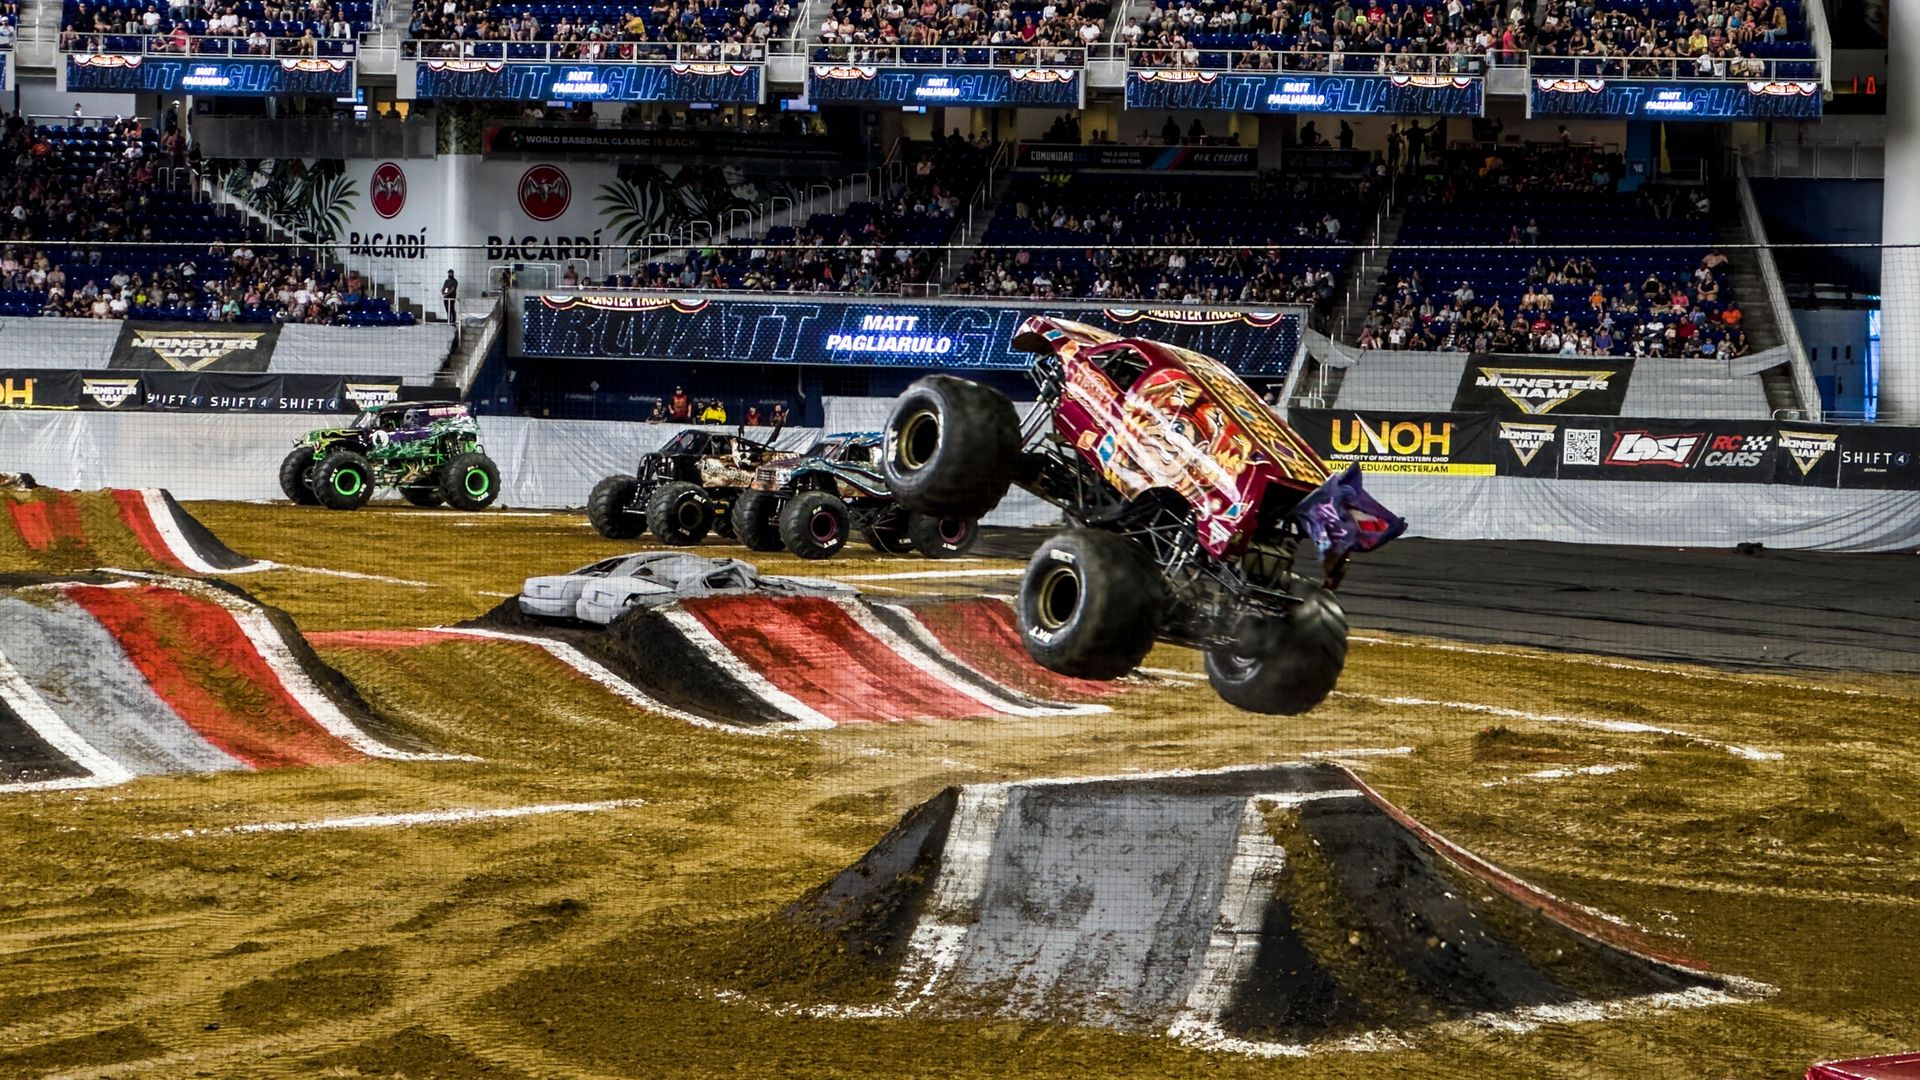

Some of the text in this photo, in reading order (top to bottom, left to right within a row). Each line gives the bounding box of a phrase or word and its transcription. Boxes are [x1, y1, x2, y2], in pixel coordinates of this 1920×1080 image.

[568, 71, 593, 82] MATT
[1284, 83, 1311, 93] MATT
[1268, 94, 1325, 105] PAGLIARULO
[526, 135, 560, 144] WORLD
[562, 136, 609, 145] BASEBALL
[611, 137, 650, 146] CLASSIC
[350, 227, 427, 259] BACARDÍ
[487, 229, 602, 261] BACARDÍ
[863, 316, 917, 332] MATT
[131, 338, 258, 350] MONSTER
[826, 334, 951, 354] PAGLIARULO
[165, 348, 220, 357] JAM
[1475, 376, 1609, 391] MONSTER
[83, 385, 138, 395] MONSTER
[346, 391, 398, 401] MONSTER
[1510, 387, 1569, 399] JAM
[99, 394, 122, 402] JAM
[210, 396, 256, 408] SHIFT
[279, 397, 325, 409] SHIFT
[1331, 413, 1450, 455] UNOH
[1499, 430, 1555, 442] MONSTER
[1514, 439, 1540, 449] JAM
[1711, 435, 1743, 450] RC
[1778, 439, 1836, 451] MONSTER
[1330, 454, 1368, 462] UNIVERSITY
[1378, 455, 1431, 463] NORTHWESTERN
[1704, 452, 1763, 467] CARS
[1793, 448, 1821, 459] JAM
[1842, 451, 1893, 464] SHIFT
[1028, 625, 1053, 644] BKT
